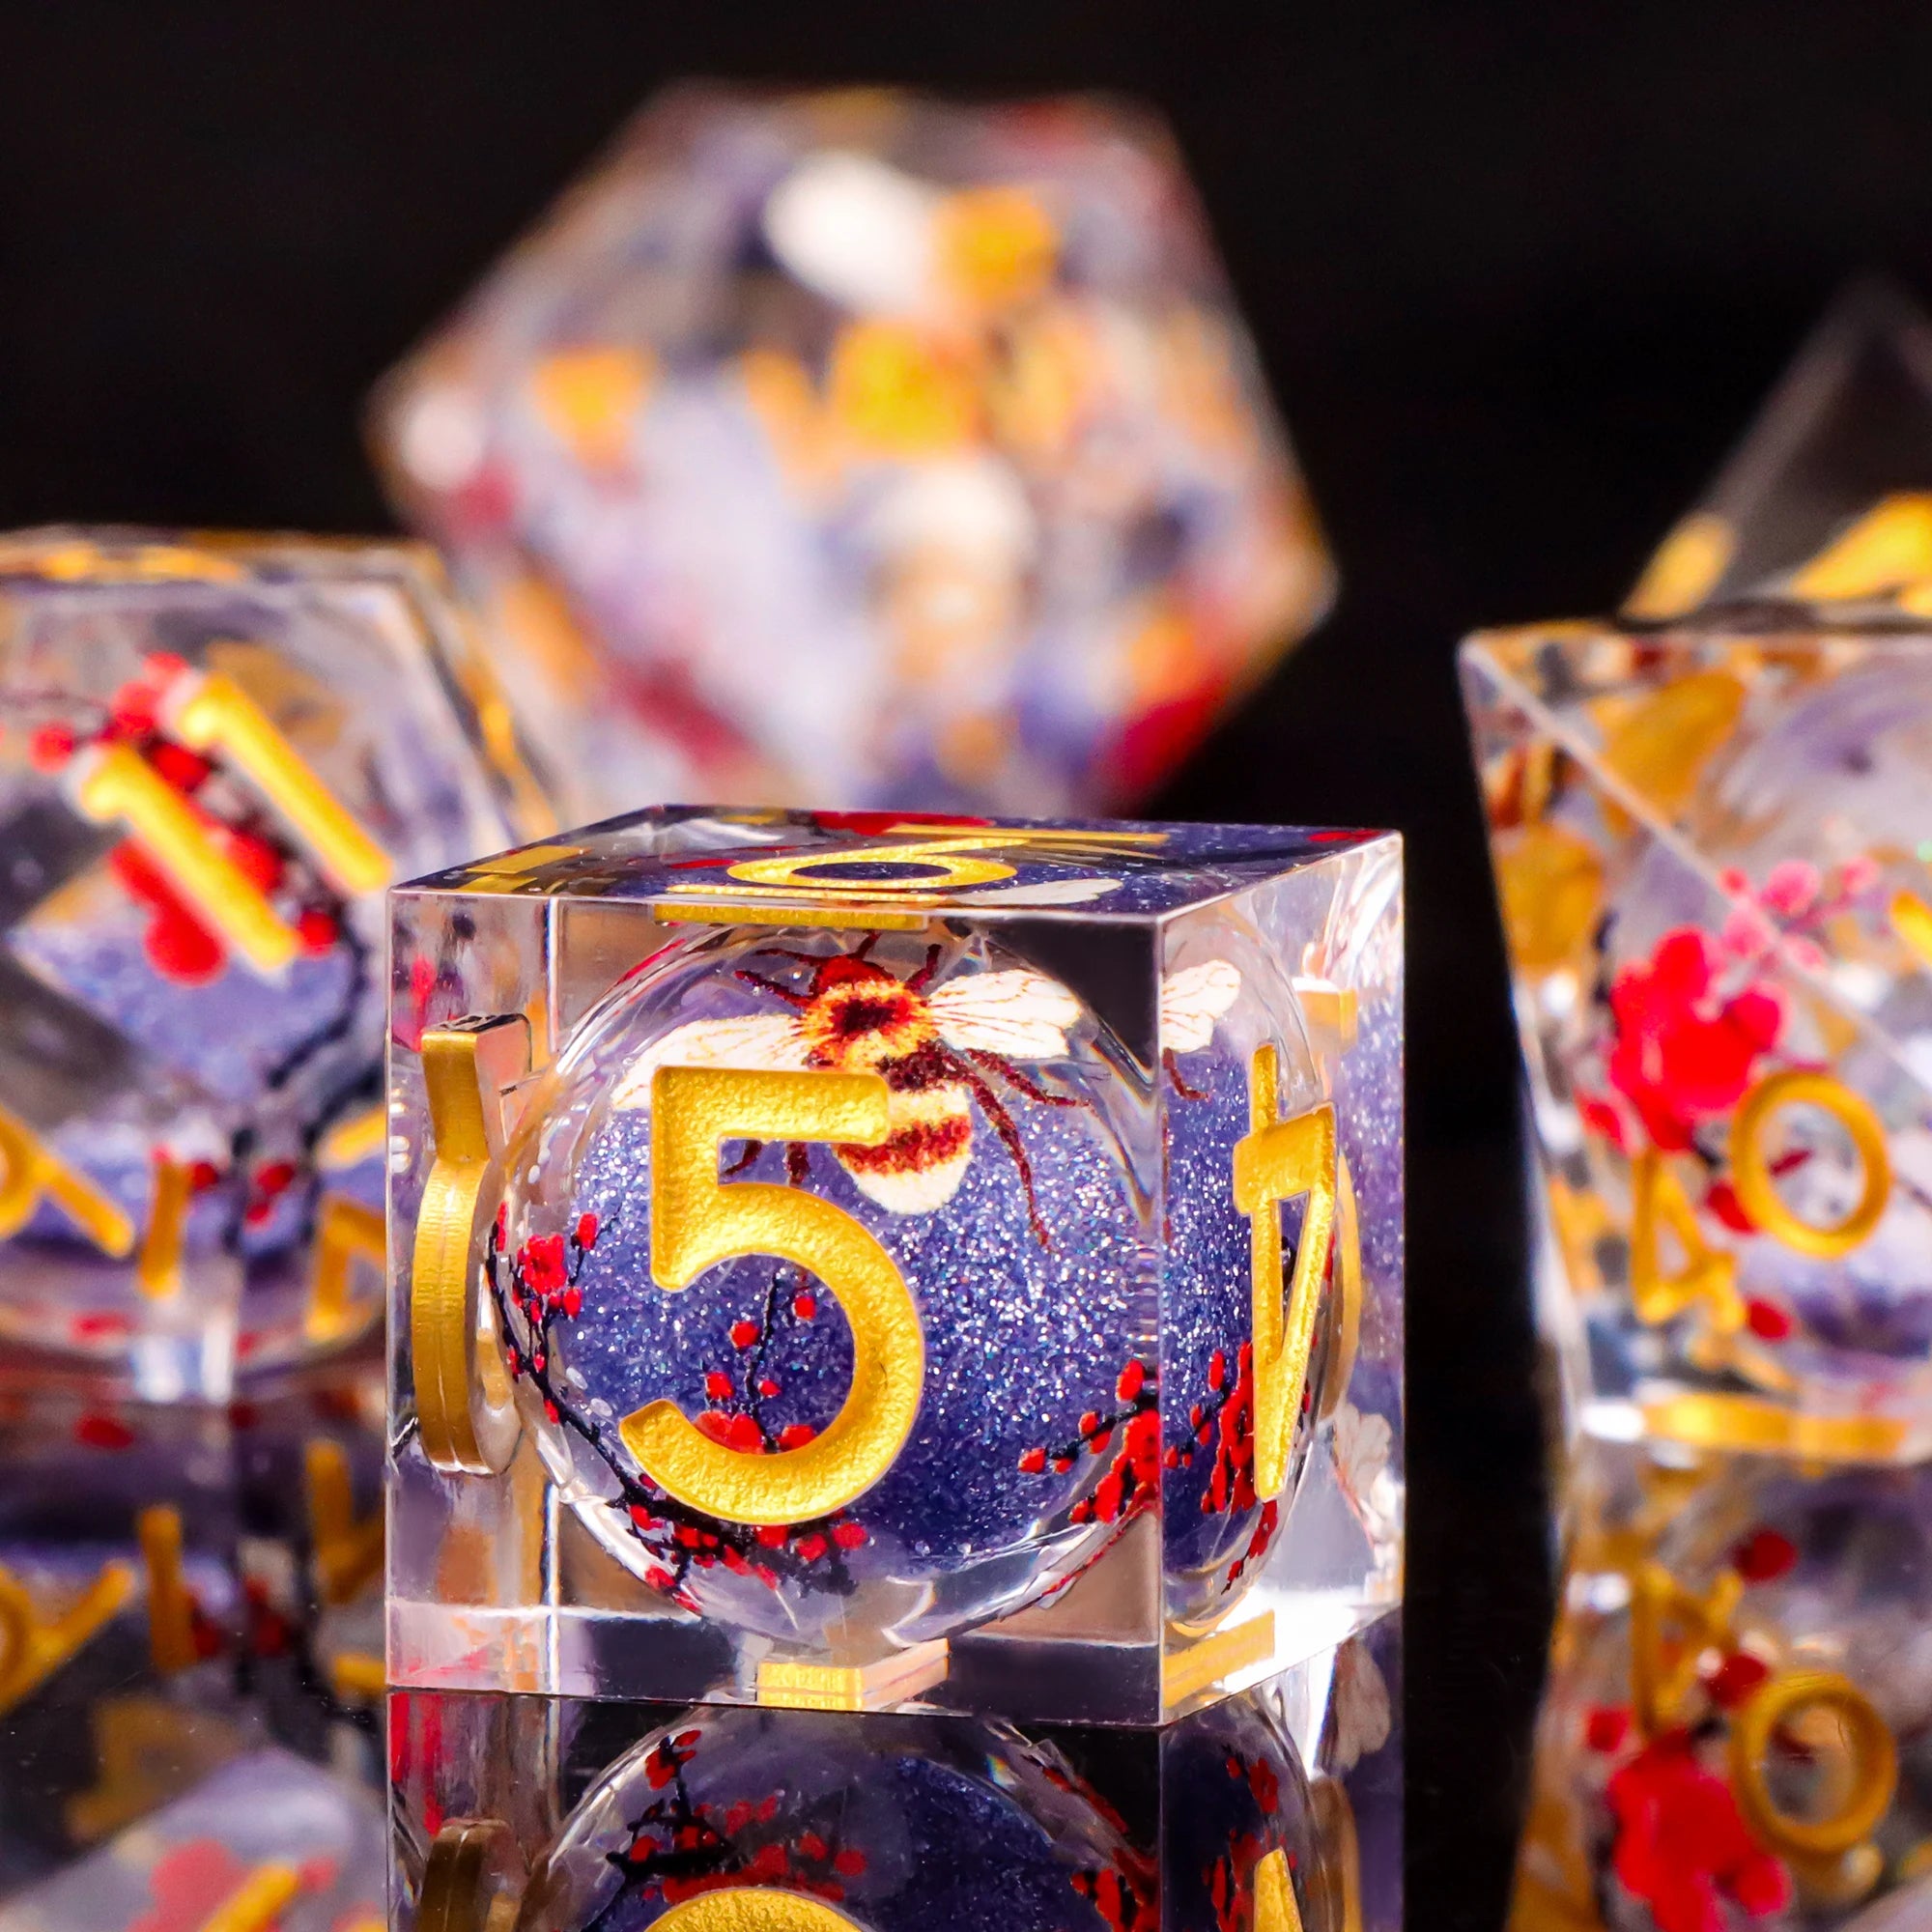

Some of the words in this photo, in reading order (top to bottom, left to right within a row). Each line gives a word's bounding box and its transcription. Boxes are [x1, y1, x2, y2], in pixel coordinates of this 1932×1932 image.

[80, 674, 391, 969] 11
[619, 1065, 925, 1525] 5
[1233, 1045, 1337, 1498] 4
